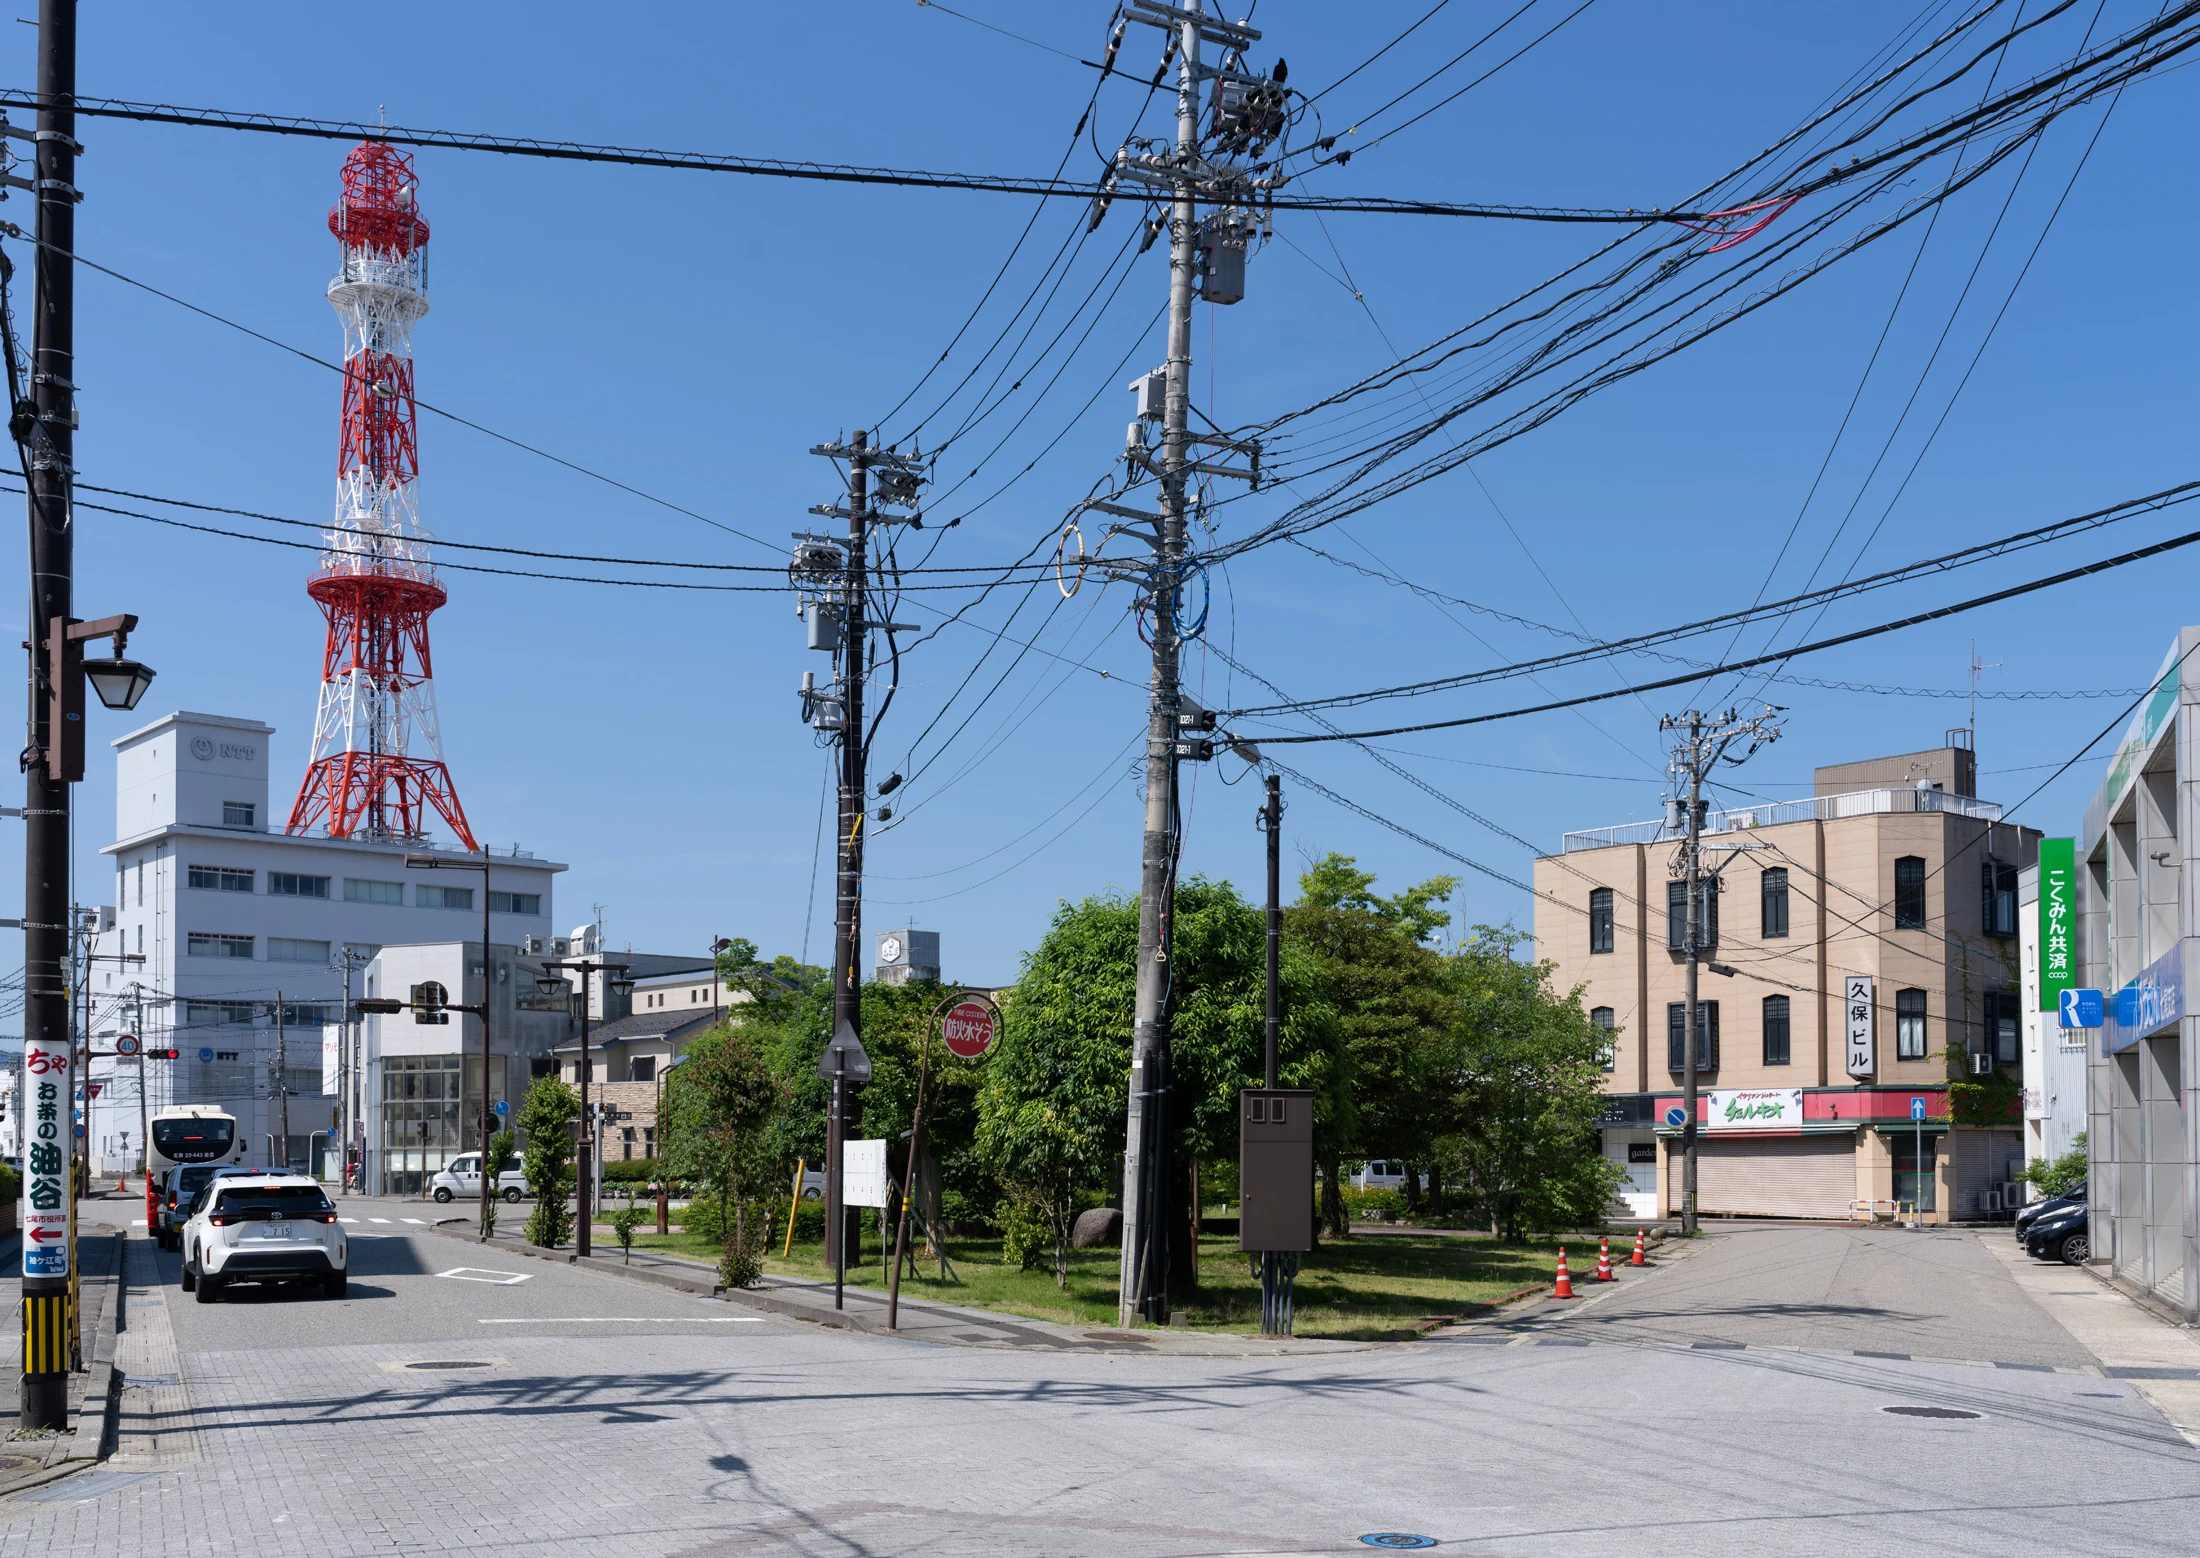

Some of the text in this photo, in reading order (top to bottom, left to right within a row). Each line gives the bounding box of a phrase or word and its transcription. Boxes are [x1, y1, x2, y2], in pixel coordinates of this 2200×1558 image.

[220, 744, 255, 760] NTT
[2048, 870, 2067, 969] こくみん共済
[966, 1011, 987, 1019] CISTERN
[1851, 982, 1869, 1068] 久保ビル
[946, 1018, 992, 1043] 防火水そう
[121, 1041, 134, 1051] 40
[216, 1051, 239, 1060] NTT
[27, 1048, 68, 1075] ちゃ
